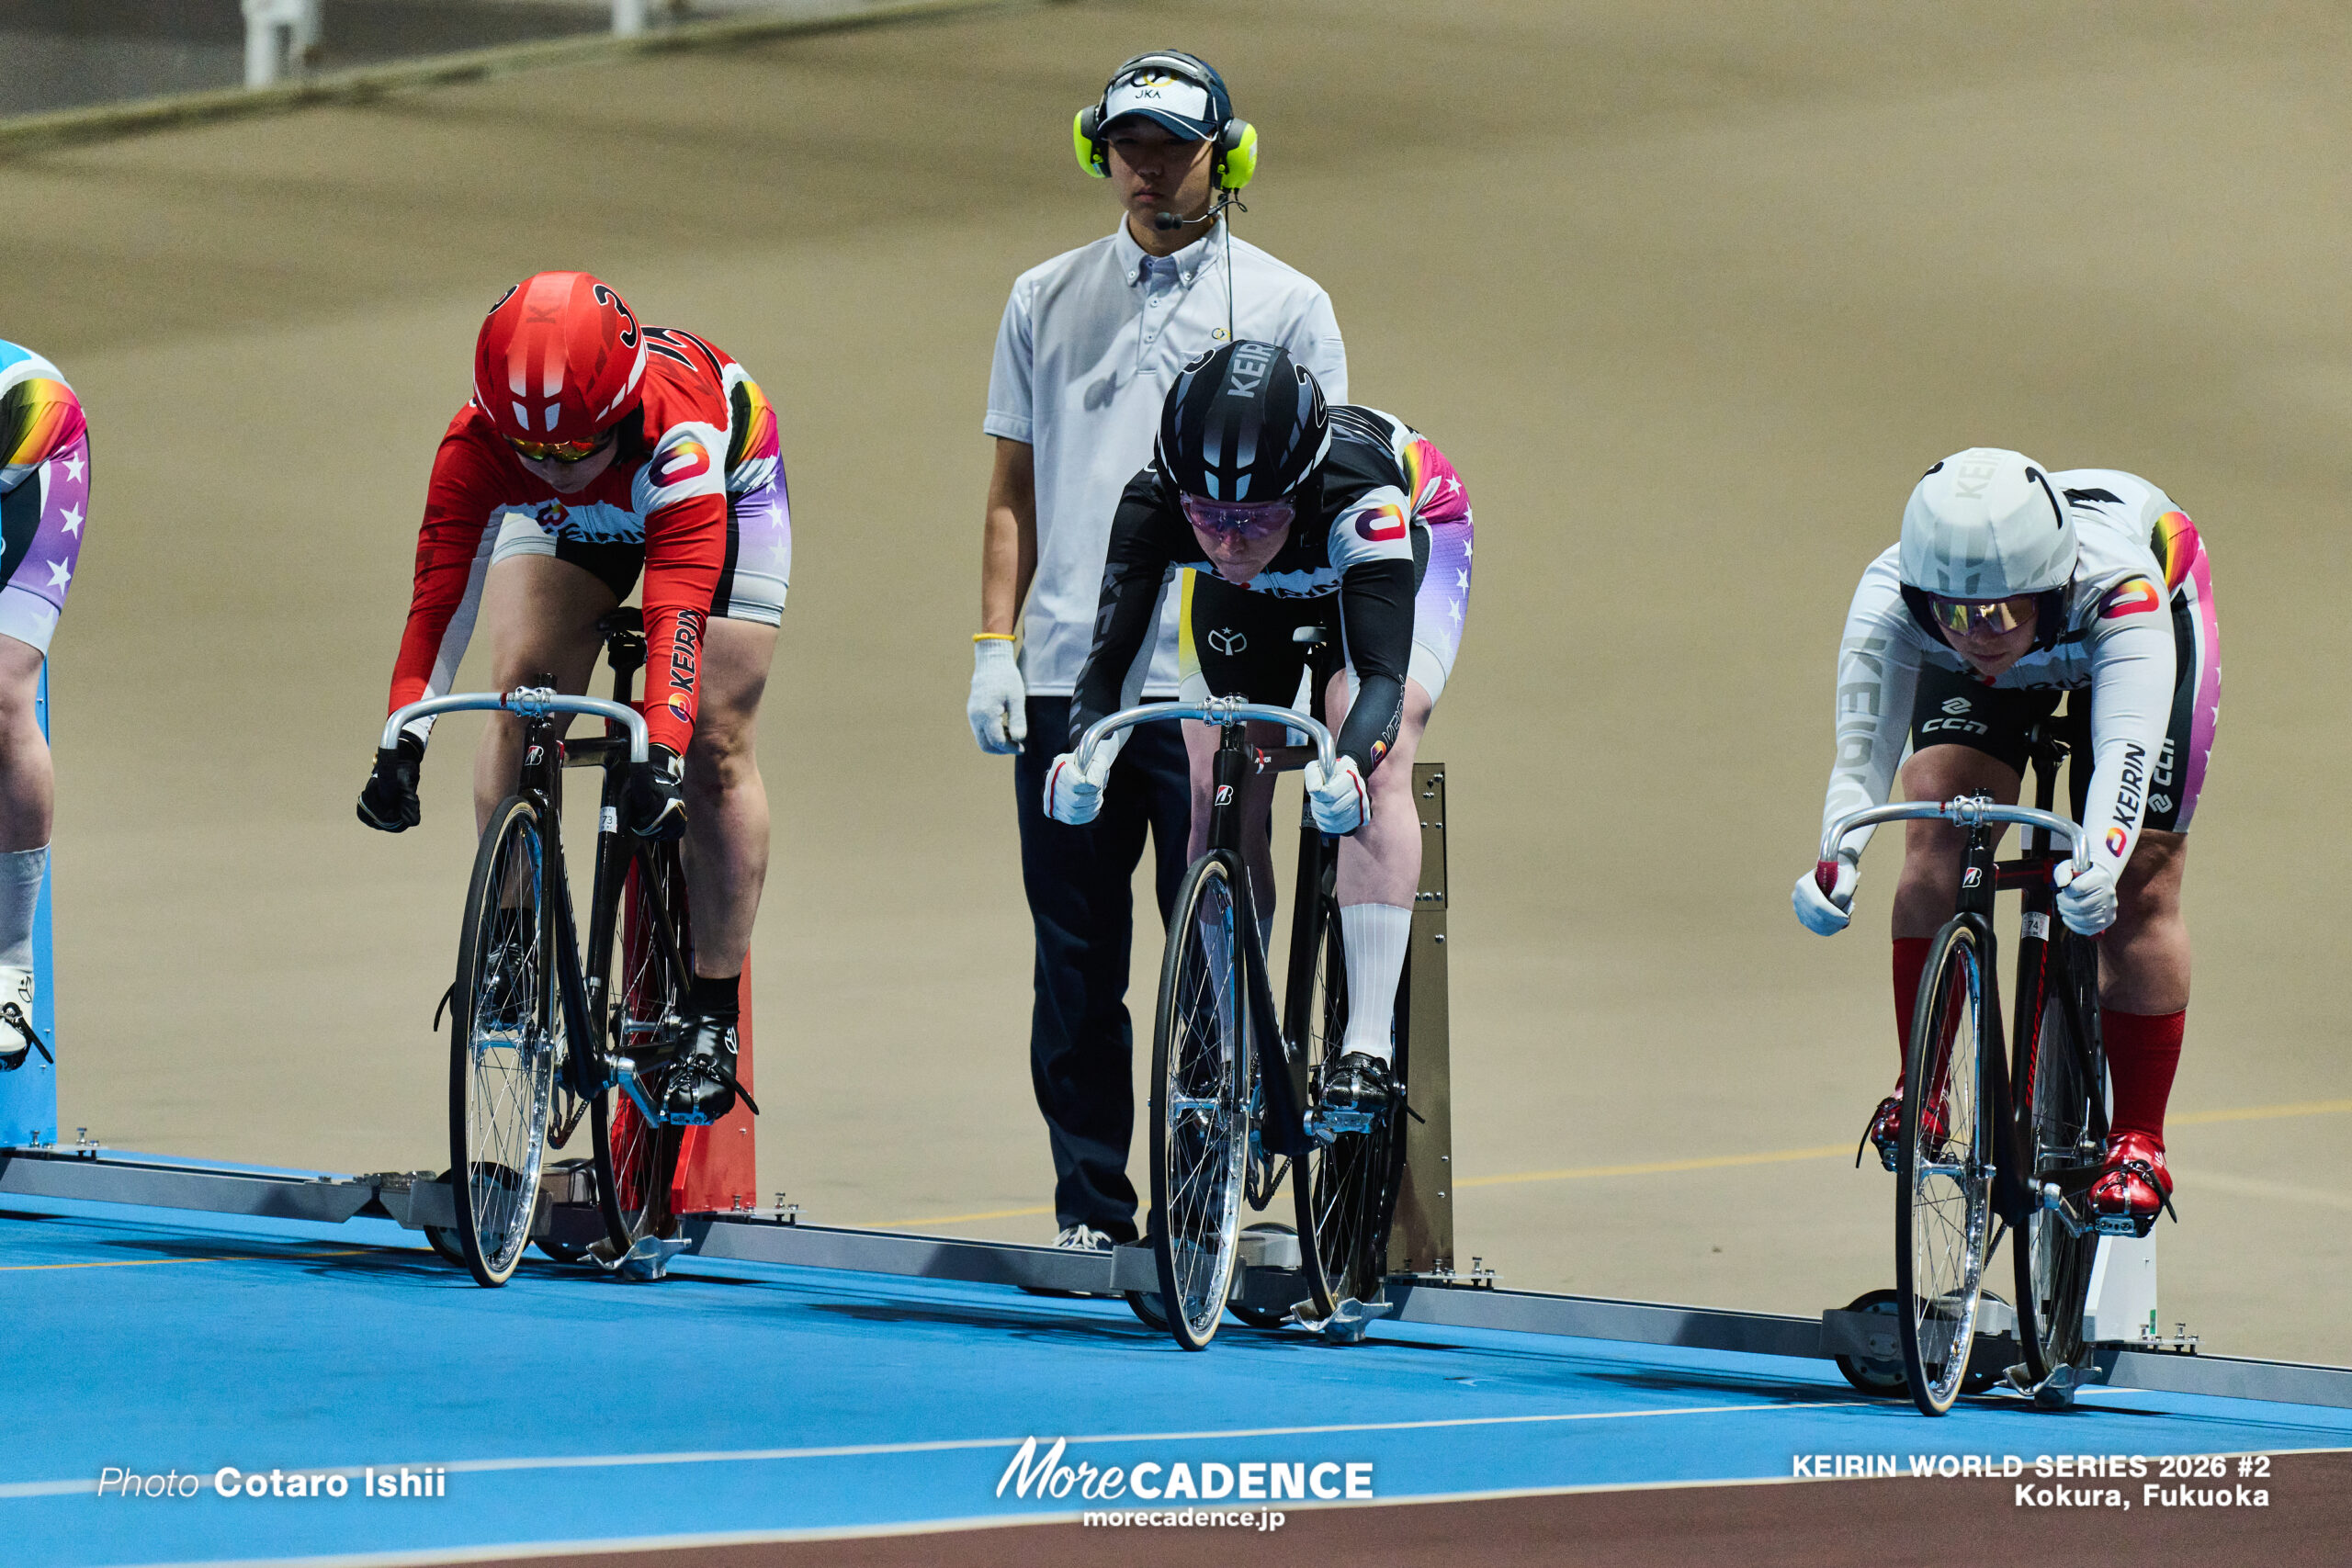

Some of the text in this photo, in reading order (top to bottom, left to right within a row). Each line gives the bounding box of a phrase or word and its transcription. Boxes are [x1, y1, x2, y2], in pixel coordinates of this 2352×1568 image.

[1135, 89, 1161, 99] JKA
[593, 283, 639, 349] 3
[1294, 363, 1329, 429] 2
[669, 609, 701, 694] KEIRIN
[2112, 742, 2146, 830] KEIRIN
[602, 815, 613, 825] 73
[2028, 920, 2039, 931] 74
